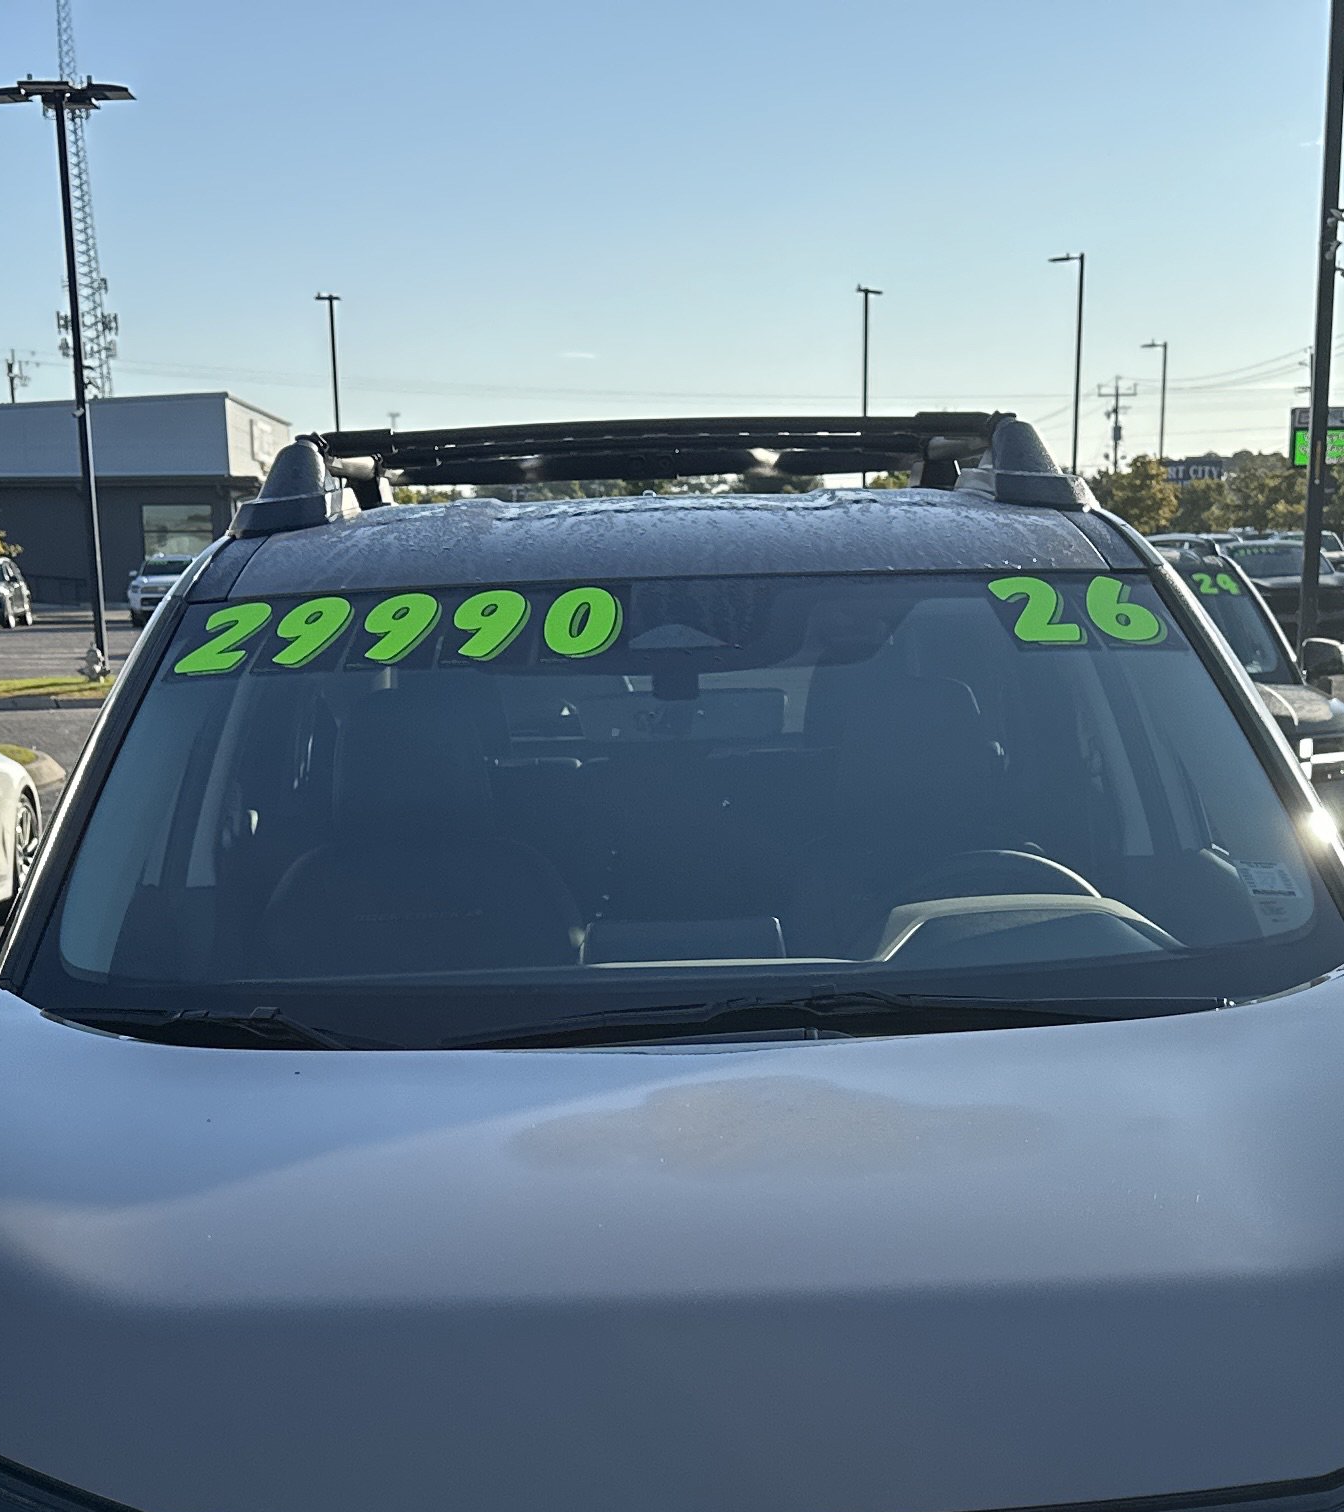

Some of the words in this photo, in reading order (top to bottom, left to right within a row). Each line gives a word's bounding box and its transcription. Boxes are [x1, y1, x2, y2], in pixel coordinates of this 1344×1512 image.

[1189, 465, 1221, 481] CITY
[1191, 572, 1241, 596] 24
[174, 586, 624, 675] 29990
[987, 576, 1168, 645] 26
